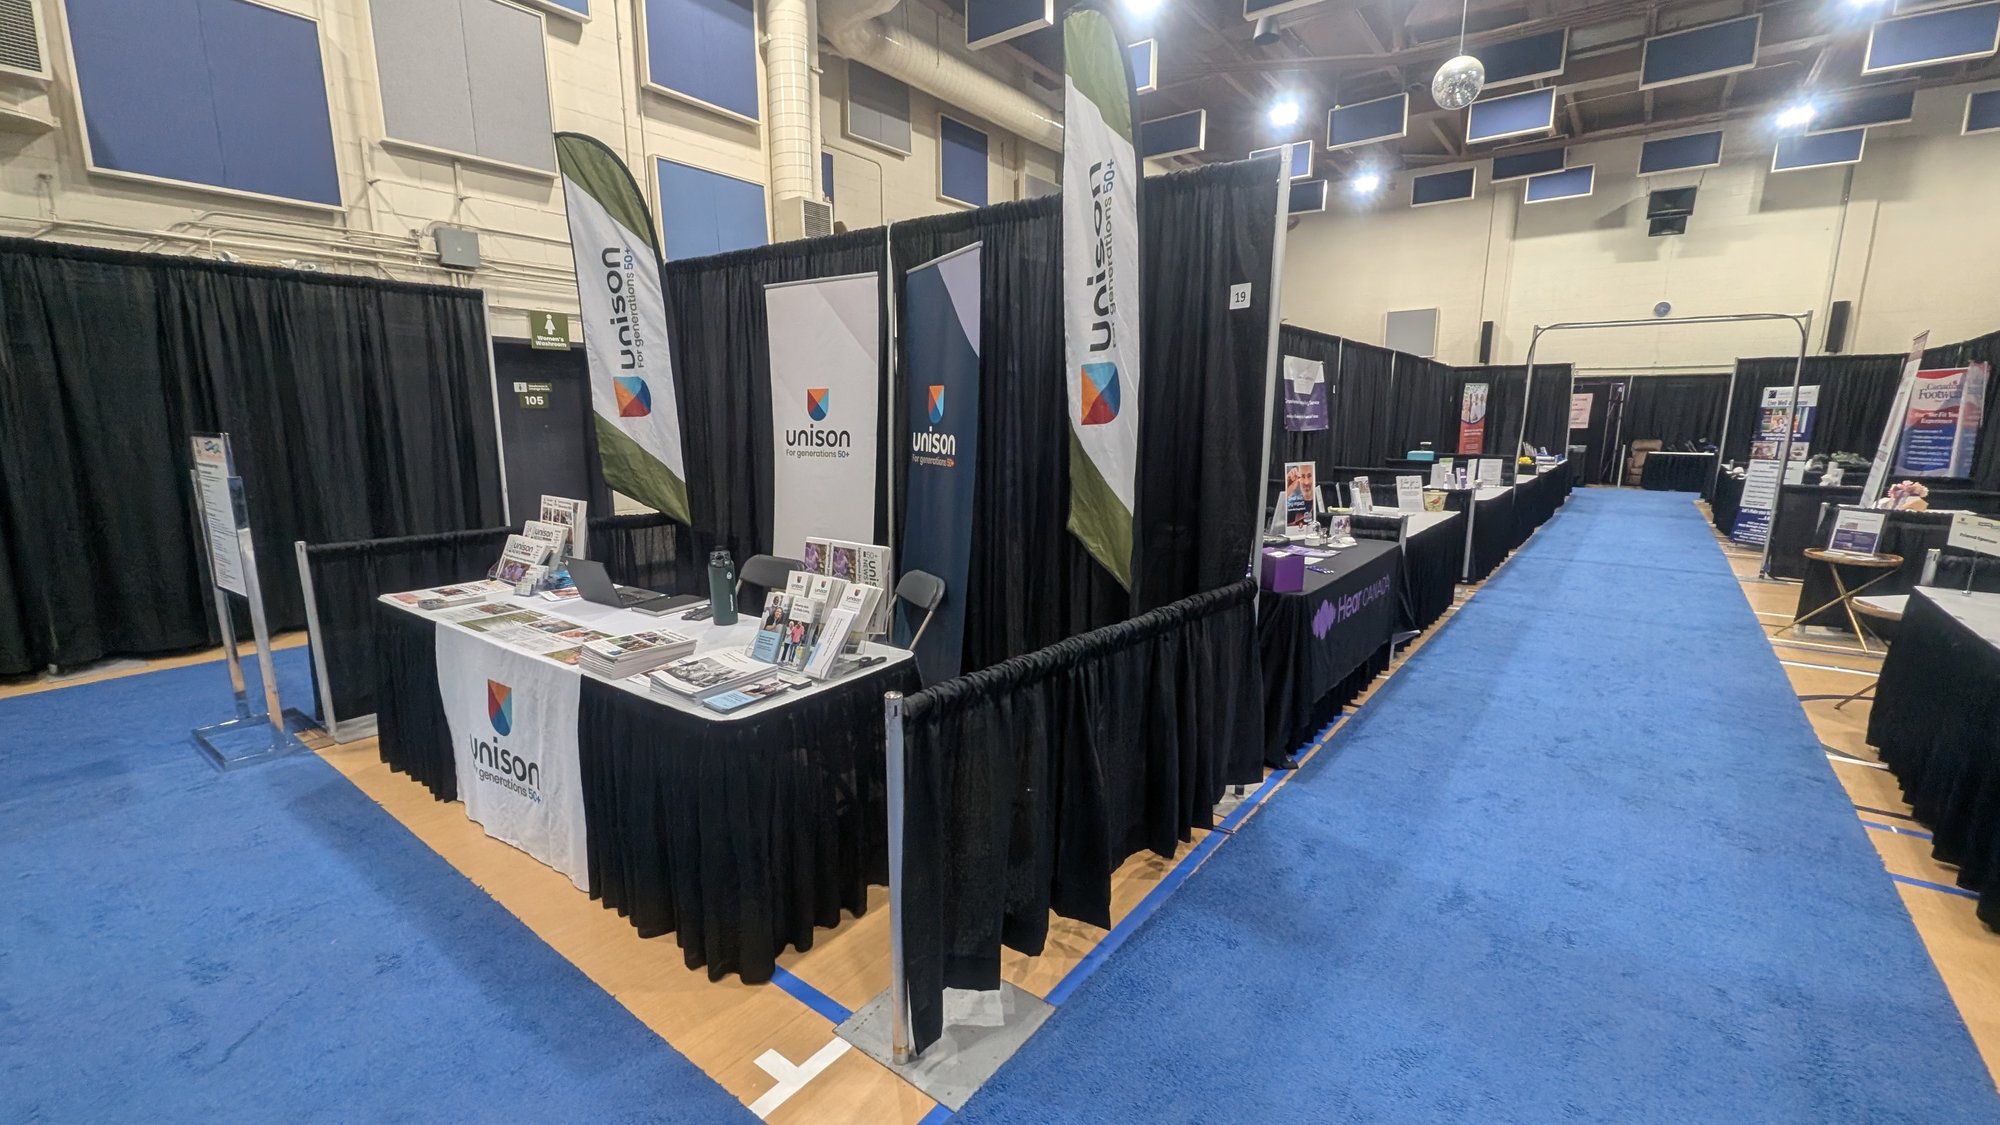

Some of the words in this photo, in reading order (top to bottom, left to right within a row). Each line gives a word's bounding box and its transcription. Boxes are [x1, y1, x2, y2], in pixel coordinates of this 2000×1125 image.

[1102, 158, 1116, 195] 50+
[623, 247, 635, 271] 50+
[1087, 161, 1112, 352] unison
[1103, 195, 1117, 317] generations
[601, 247, 636, 370] unison
[1234, 291, 1246, 303] 19
[625, 272, 645, 348] generations
[535, 340, 567, 348] Washroom
[536, 335, 565, 343] Women's
[637, 349, 645, 369] For
[524, 395, 544, 405] 105
[785, 423, 851, 448] unison
[912, 425, 956, 456] unison
[785, 449, 797, 457] For
[797, 449, 837, 458] generations
[837, 450, 850, 459] 50+
[911, 453, 920, 463] For
[919, 455, 947, 467] generations
[534, 527, 554, 538] unison
[513, 541, 534, 554] unison
[868, 560, 879, 587] unis
[1337, 591, 1363, 624] Hear
[1362, 573, 1391, 607] CANADA
[469, 733, 541, 791] unison
[478, 768, 528, 797] generations
[527, 788, 542, 804] 50+
